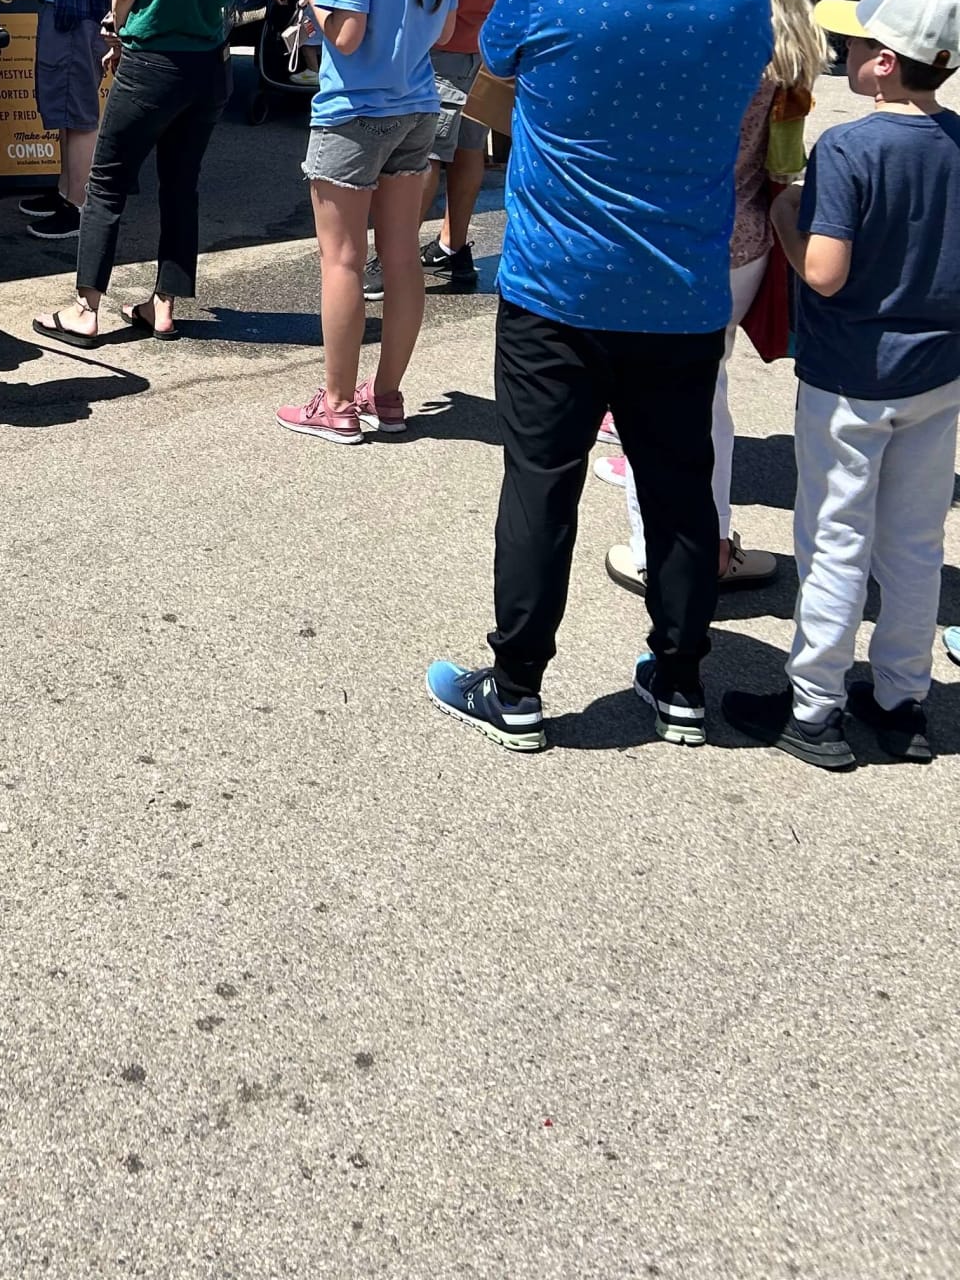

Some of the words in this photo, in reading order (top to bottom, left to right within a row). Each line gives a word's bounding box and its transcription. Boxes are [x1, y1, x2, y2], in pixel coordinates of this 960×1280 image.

[13, 110, 37, 121] FRIED
[14, 131, 40, 141] Make
[7, 143, 54, 159] COMBO
